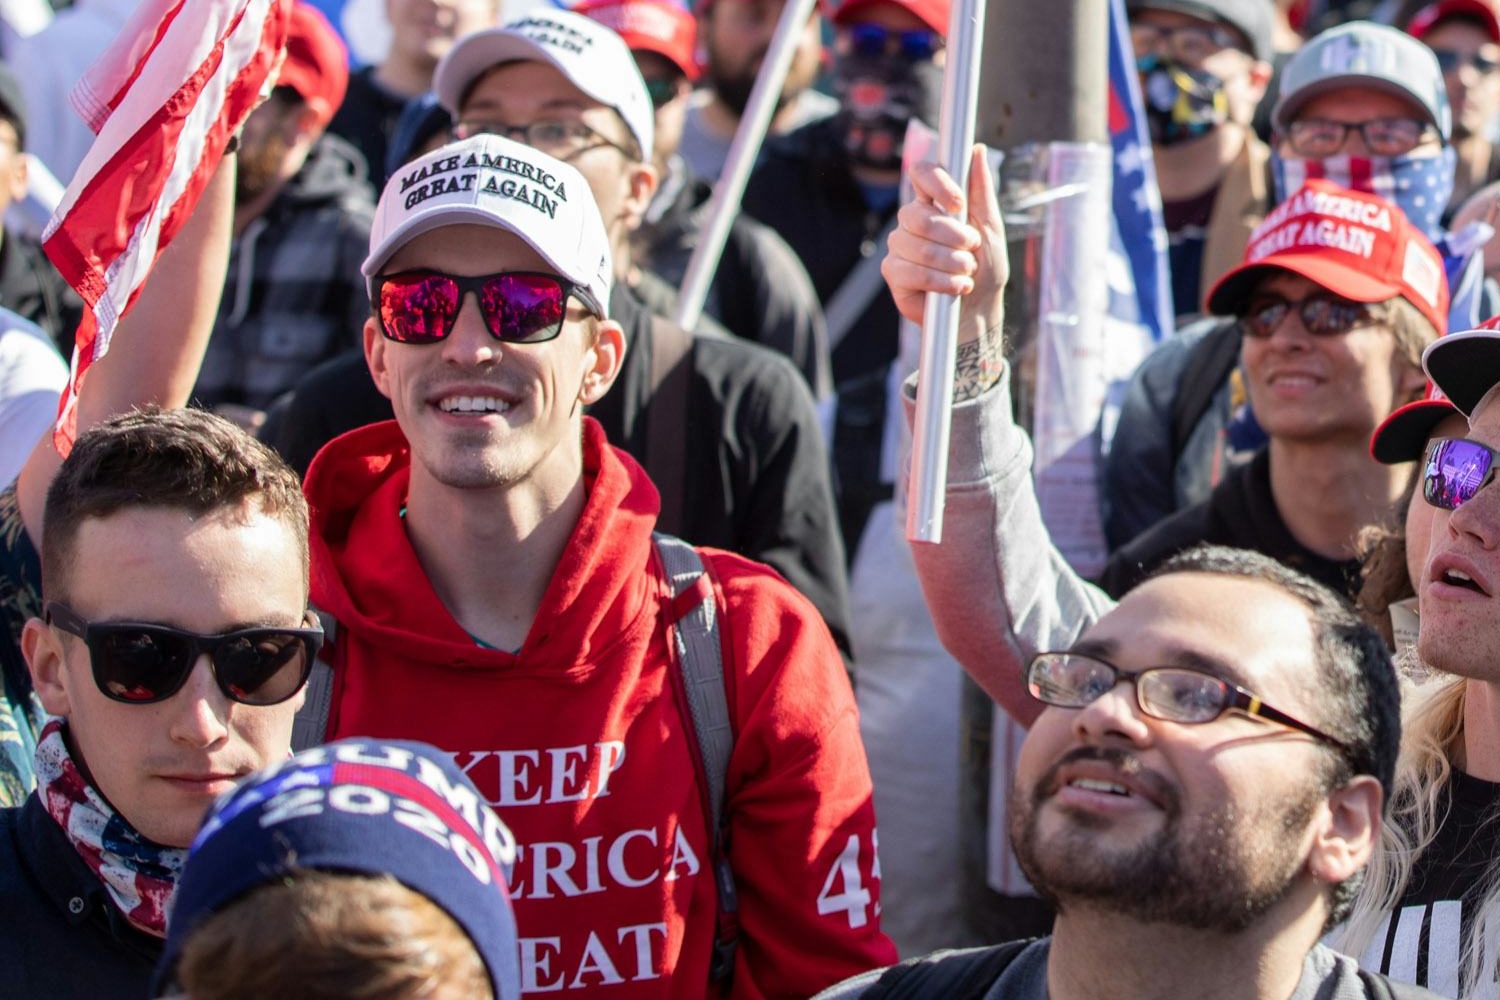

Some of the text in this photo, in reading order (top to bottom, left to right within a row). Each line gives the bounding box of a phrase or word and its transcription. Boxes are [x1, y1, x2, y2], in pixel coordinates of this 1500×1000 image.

[400, 153, 568, 202] MAKE AMERICA
[405, 173, 559, 219] GREAT AGAIN
[1299, 220, 1376, 259] AGAIN
[262, 744, 517, 866] UMP
[447, 739, 626, 808] KEEP
[259, 783, 492, 886] 2020
[510, 823, 701, 901] RICA
[518, 922, 669, 994] EAT
